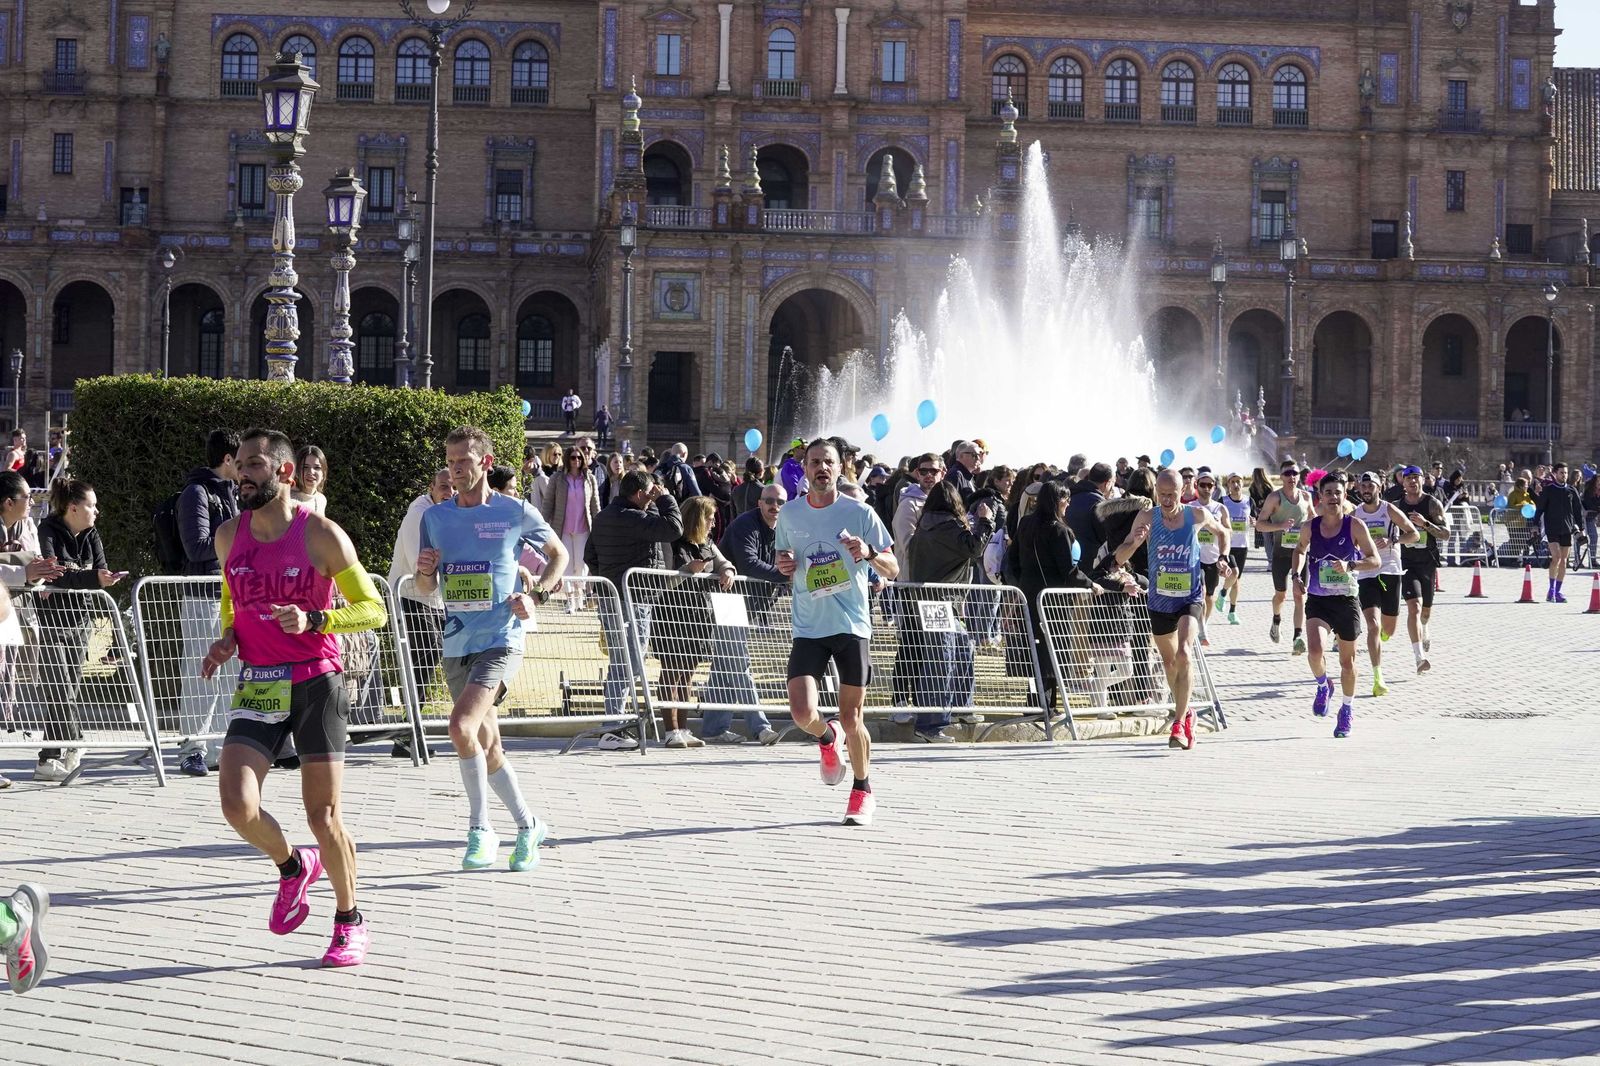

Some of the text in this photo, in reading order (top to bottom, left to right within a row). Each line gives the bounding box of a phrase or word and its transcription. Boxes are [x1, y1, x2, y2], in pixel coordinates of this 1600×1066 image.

[812, 553, 838, 564] ZURICH
[455, 564, 485, 572] ZURICH
[457, 579, 472, 587] 1741
[813, 575, 838, 588] RUSO
[1164, 582, 1182, 590] GREG
[446, 588, 490, 600] BAPTISTE
[254, 669, 285, 679] ZURICH
[239, 696, 281, 711] NÉSTOR
